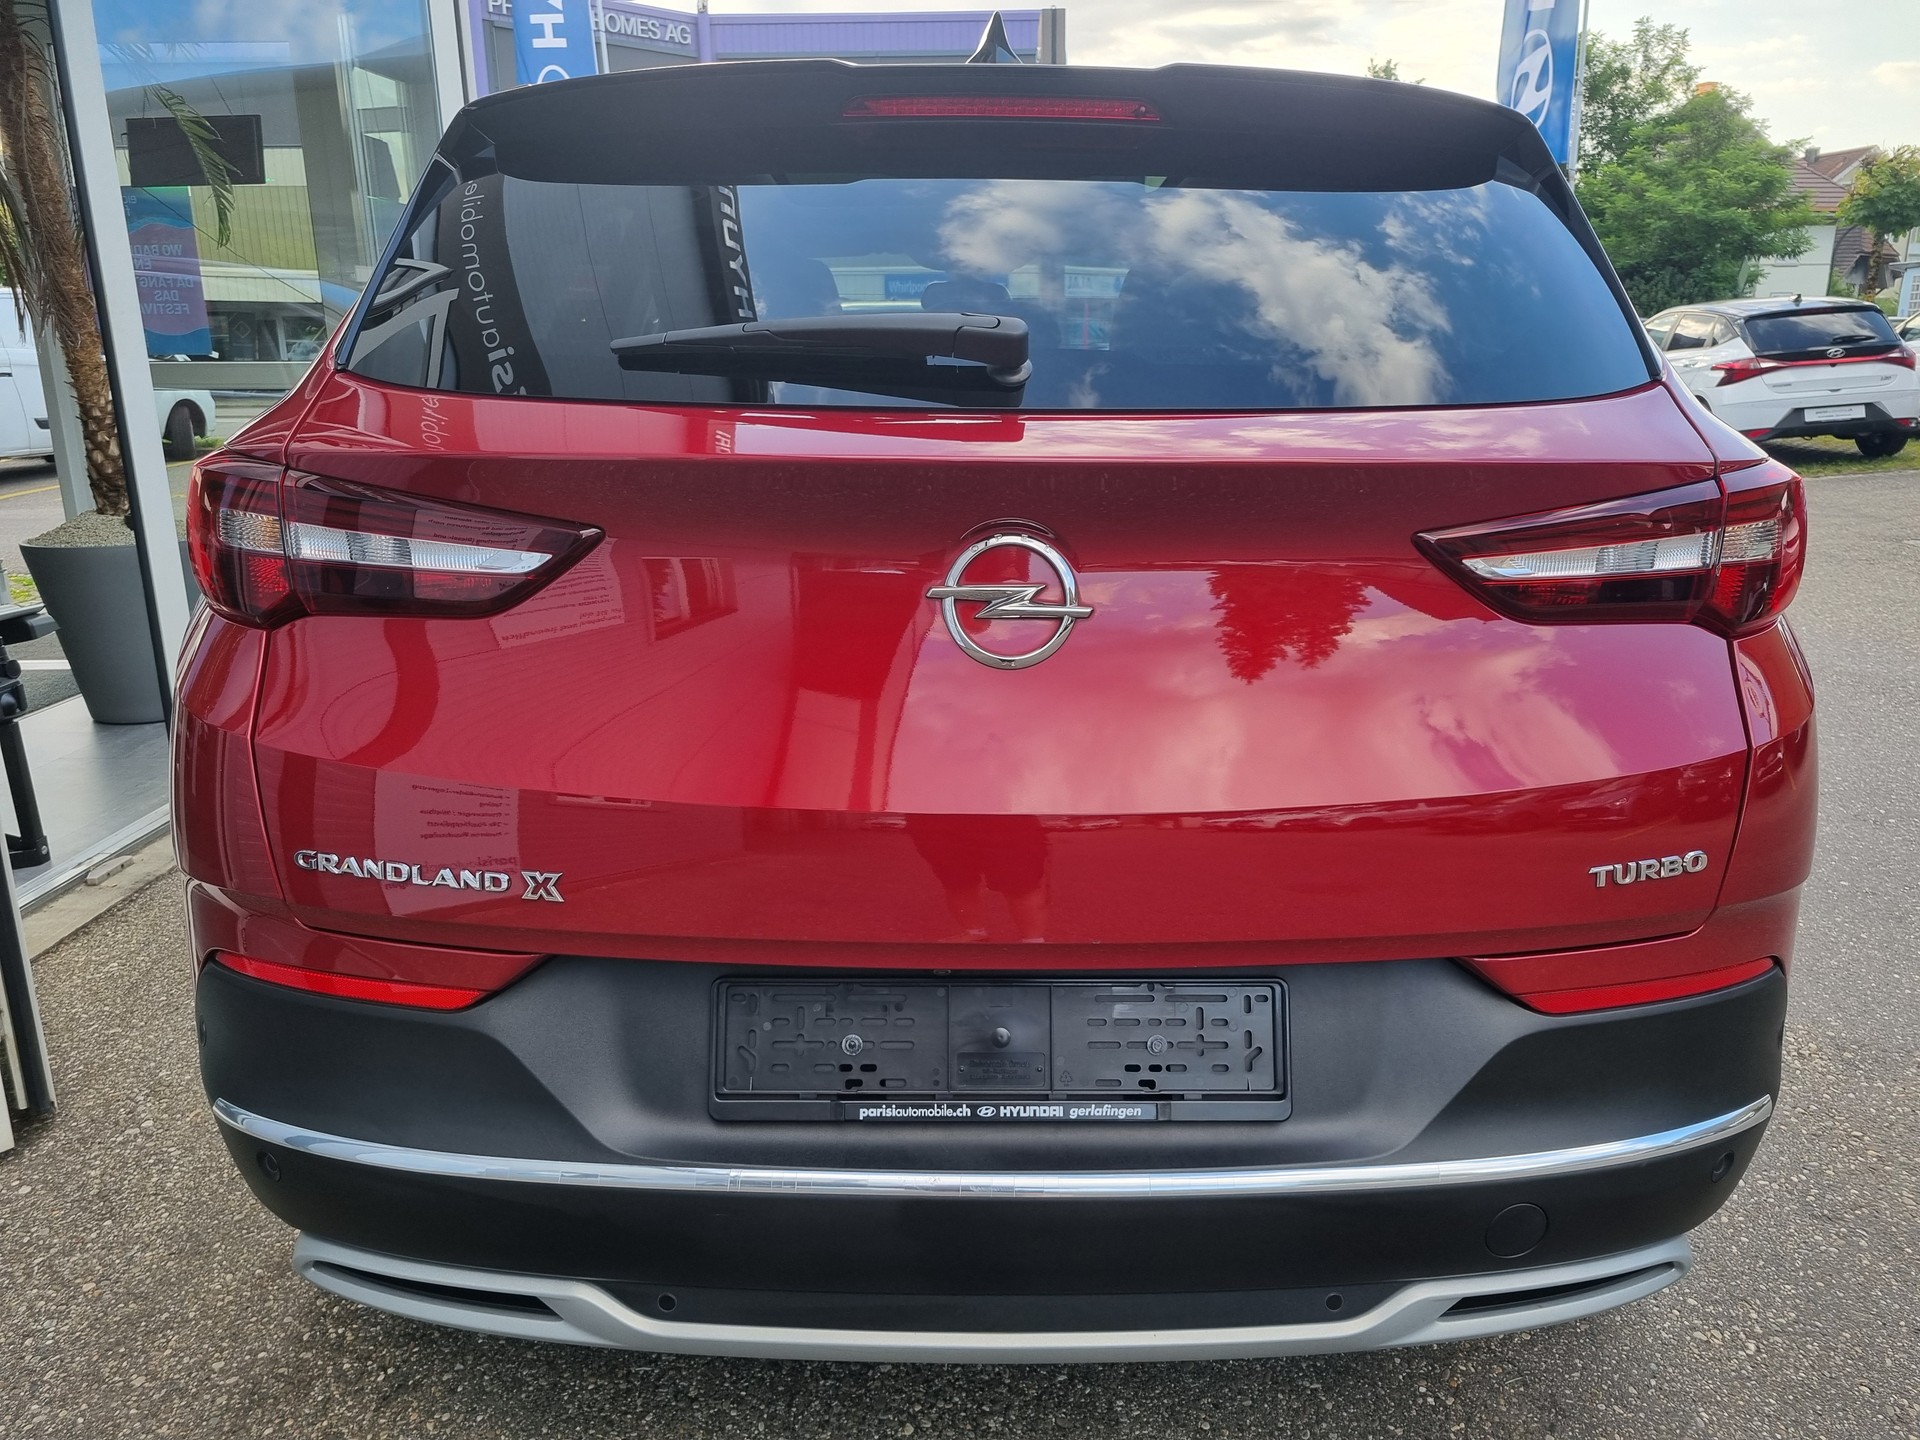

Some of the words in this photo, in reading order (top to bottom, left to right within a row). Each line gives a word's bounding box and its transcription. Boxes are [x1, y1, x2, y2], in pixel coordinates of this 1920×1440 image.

[665, 23, 692, 44] AG
[294, 849, 511, 892] GRANDLAND
[521, 870, 565, 903] X
[1588, 849, 1708, 888] TURBO
[859, 1103, 971, 1120] parisiautomobile.ch
[999, 1105, 1064, 1118] HYUNDAI
[1069, 1103, 1142, 1120] gerlafingen
